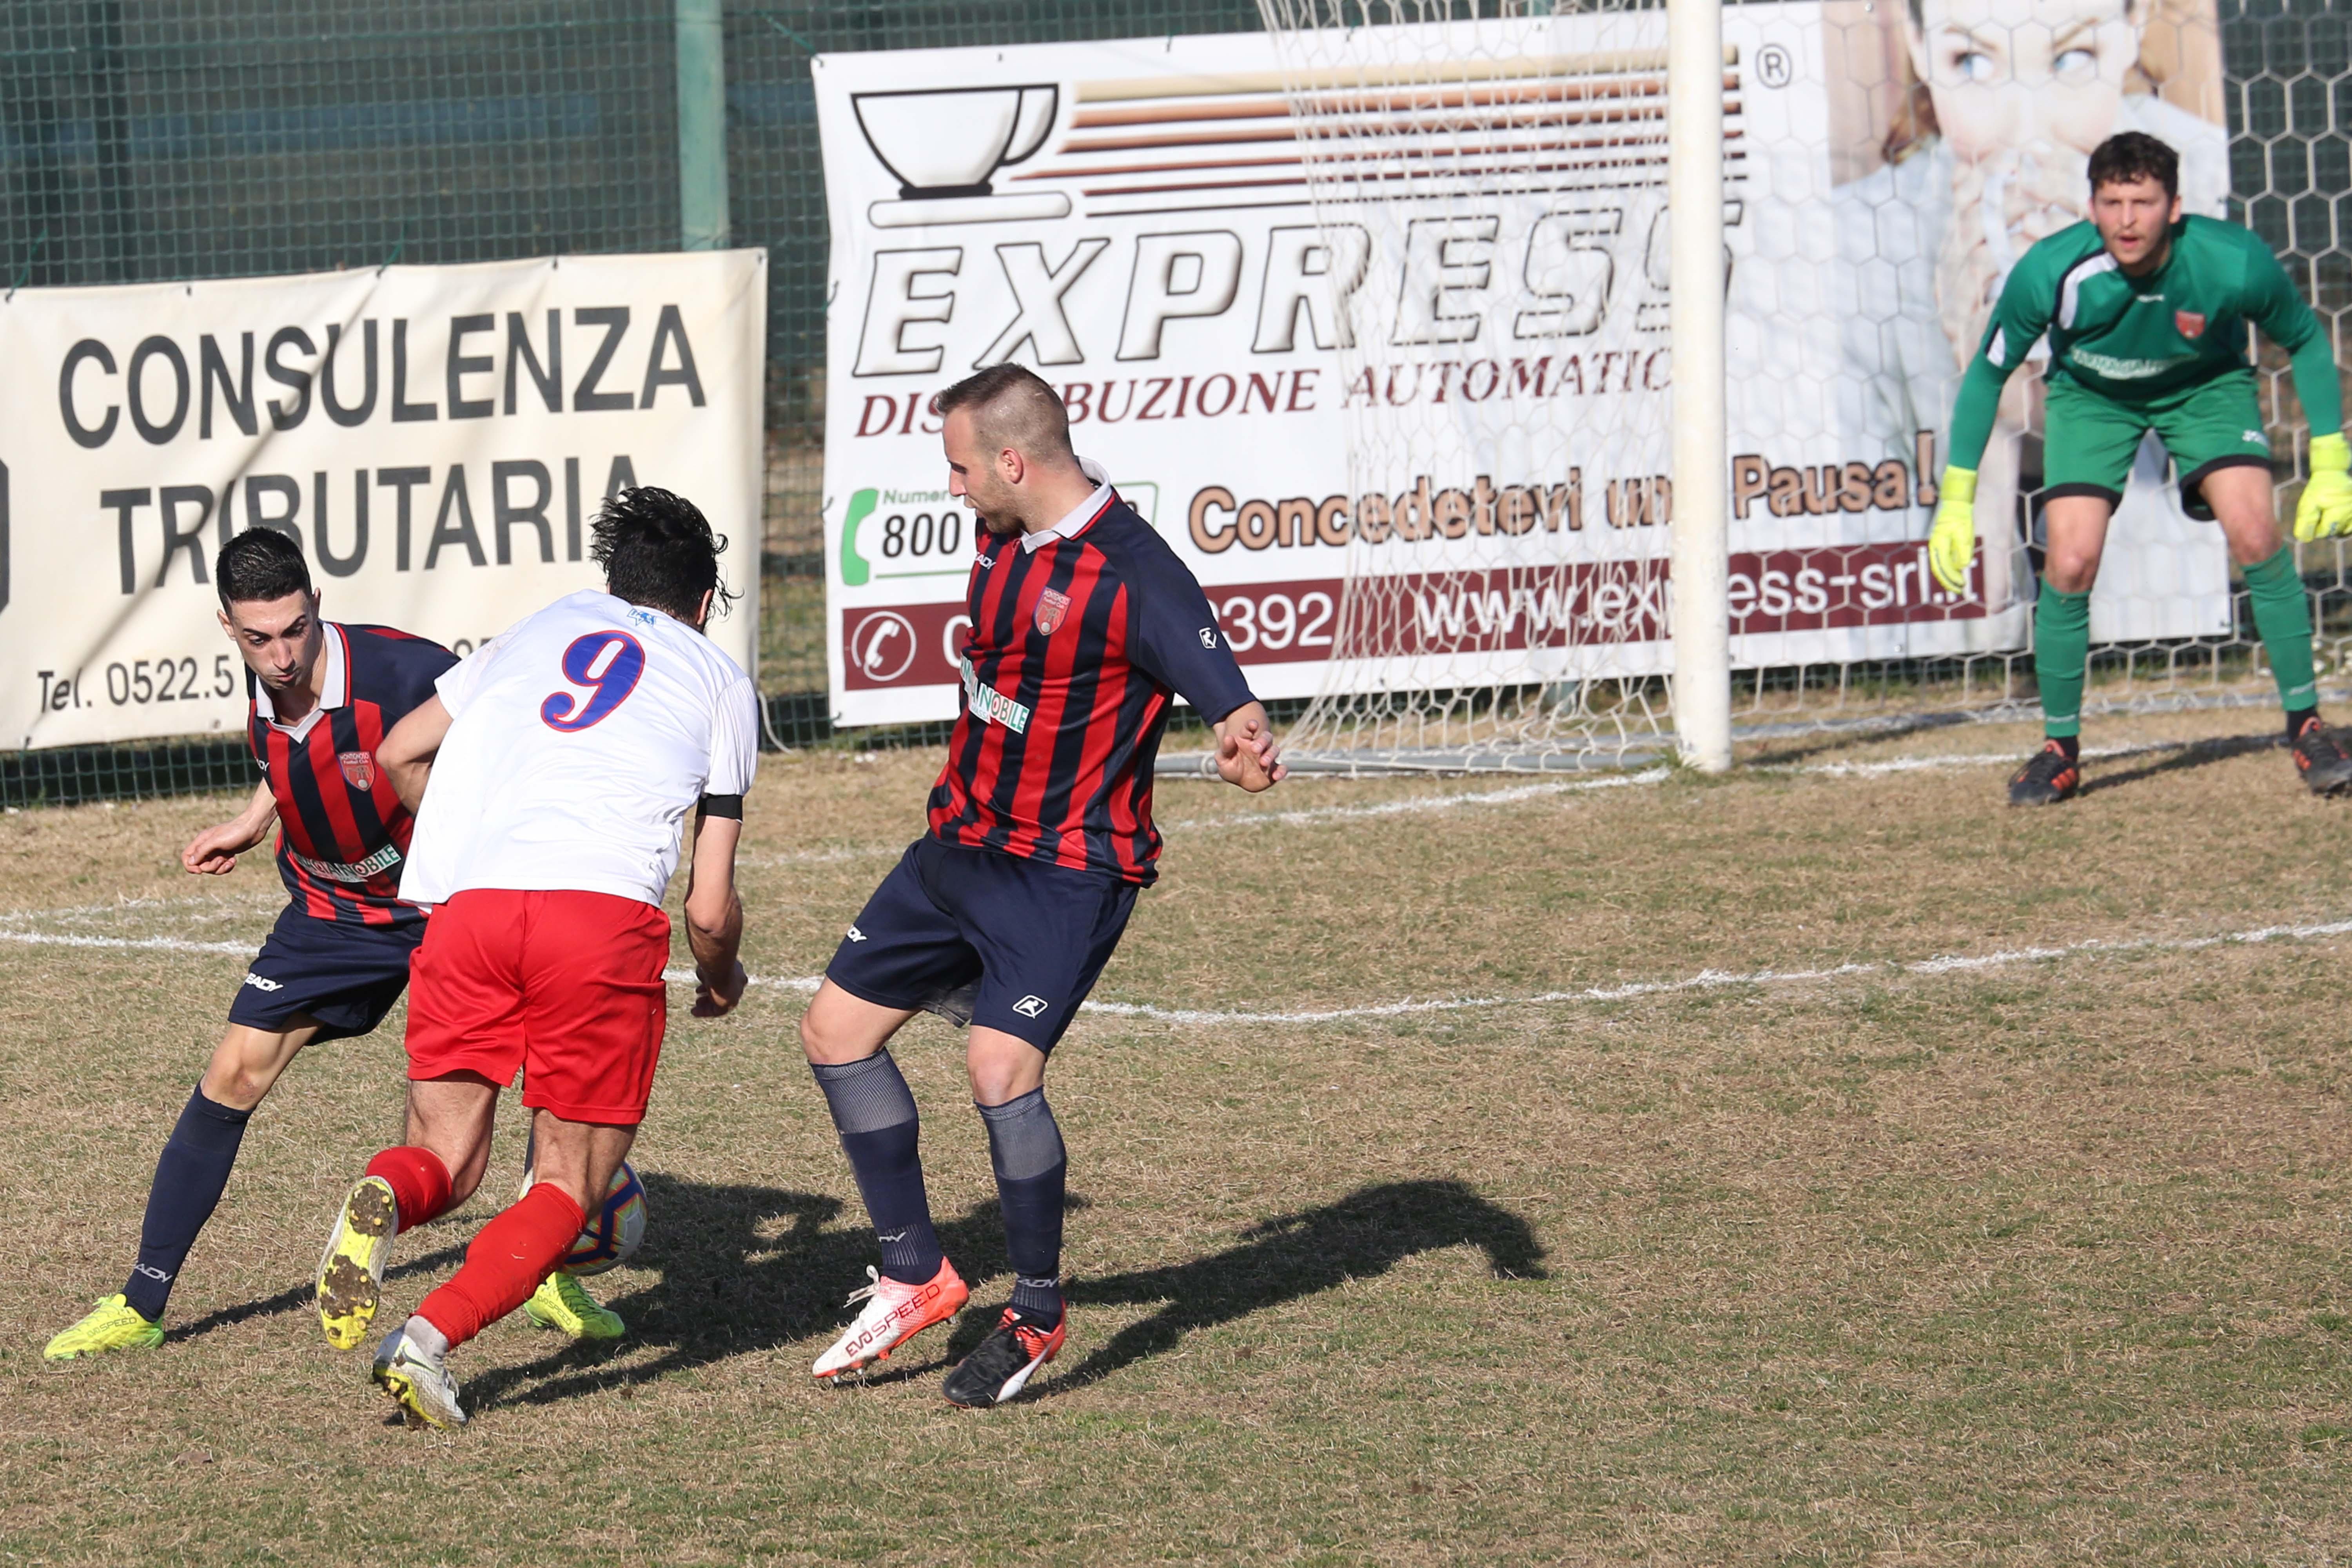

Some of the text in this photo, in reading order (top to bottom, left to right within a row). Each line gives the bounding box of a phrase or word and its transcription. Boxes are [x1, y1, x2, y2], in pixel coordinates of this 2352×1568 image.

[851, 200, 1744, 378] EXPRESS
[58, 303, 707, 449] CONSULENZA
[854, 348, 1671, 437] DISBUZIONE AUTOMATIC
[884, 511, 961, 557] 800
[1188, 465, 1584, 554] Concedetevi
[1207, 591, 1334, 652] 392
[38, 667, 92, 713] Tel.
[541, 629, 646, 732] 9
